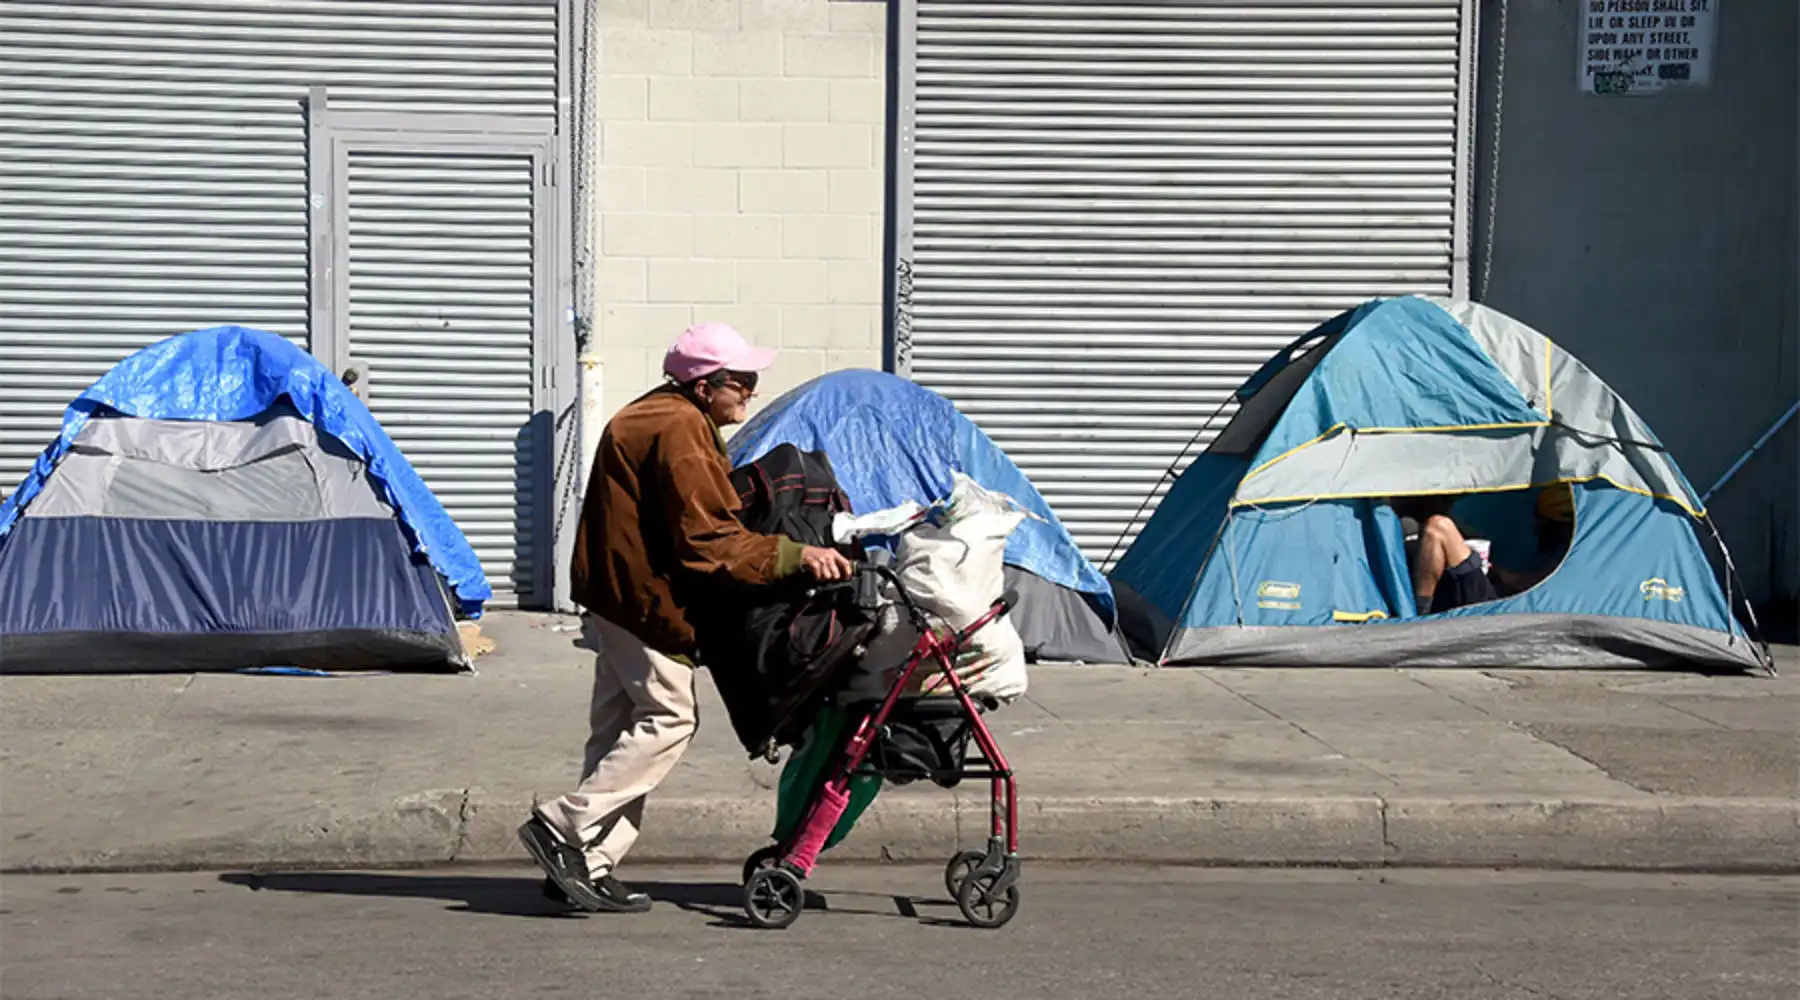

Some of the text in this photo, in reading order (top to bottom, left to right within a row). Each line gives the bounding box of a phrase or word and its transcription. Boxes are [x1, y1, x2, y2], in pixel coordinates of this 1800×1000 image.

[1589, 0, 1604, 12] NO
[1607, 0, 1648, 12] PERSON
[1652, 0, 1686, 12] SHALL
[1588, 16, 1695, 28] LIE OR SLEEP IN OR
[1587, 31, 1691, 44] UPON ANY STREET,
[1646, 48, 1660, 61] OR
[1664, 48, 1698, 61] OTHER
